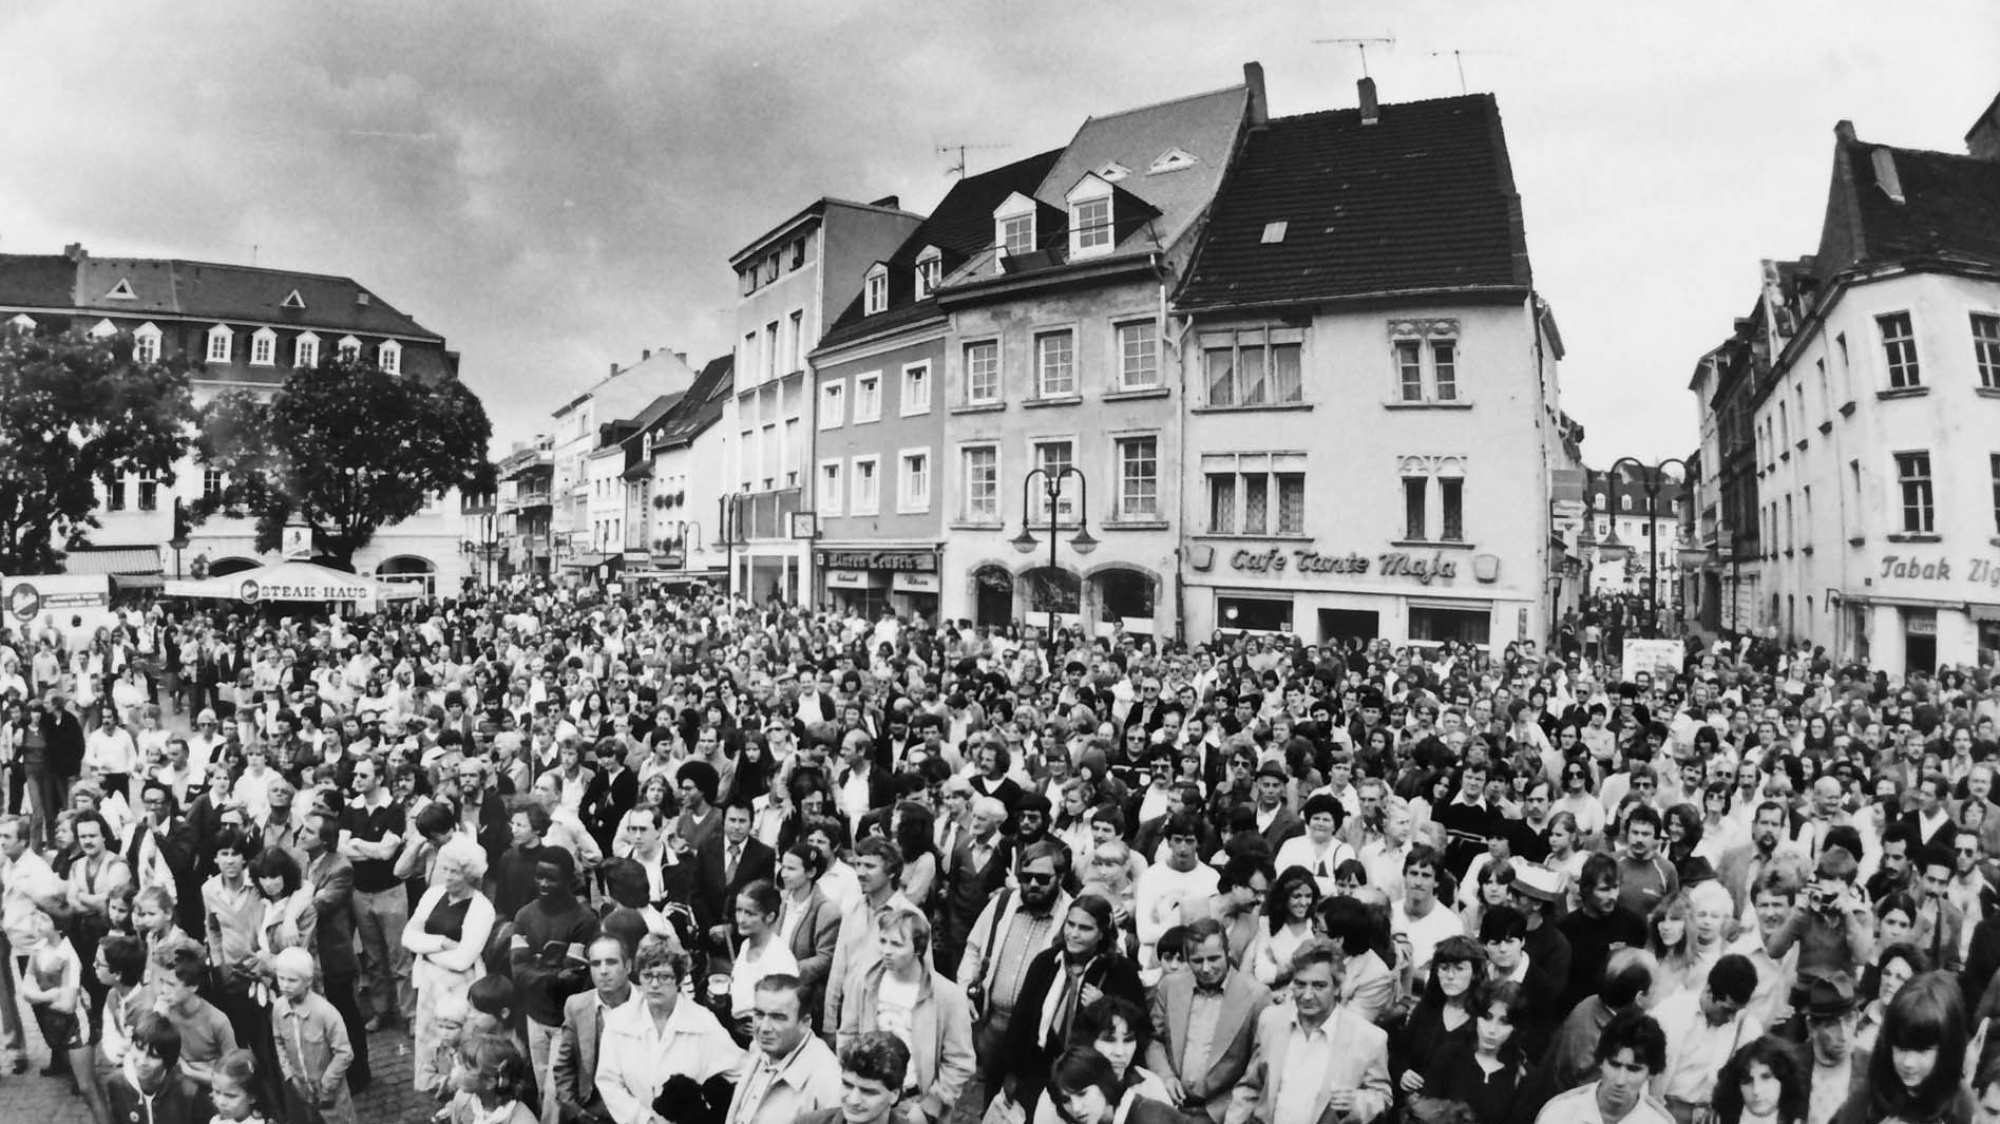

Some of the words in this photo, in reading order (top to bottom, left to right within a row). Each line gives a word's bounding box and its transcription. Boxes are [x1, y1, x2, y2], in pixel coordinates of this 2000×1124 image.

[1292, 550, 1370, 574] Tante
[1379, 550, 1457, 586] Maja
[1880, 556, 1951, 580] Tabak
[1966, 557, 2000, 588] Zig
[323, 586, 368, 599] HAUS
